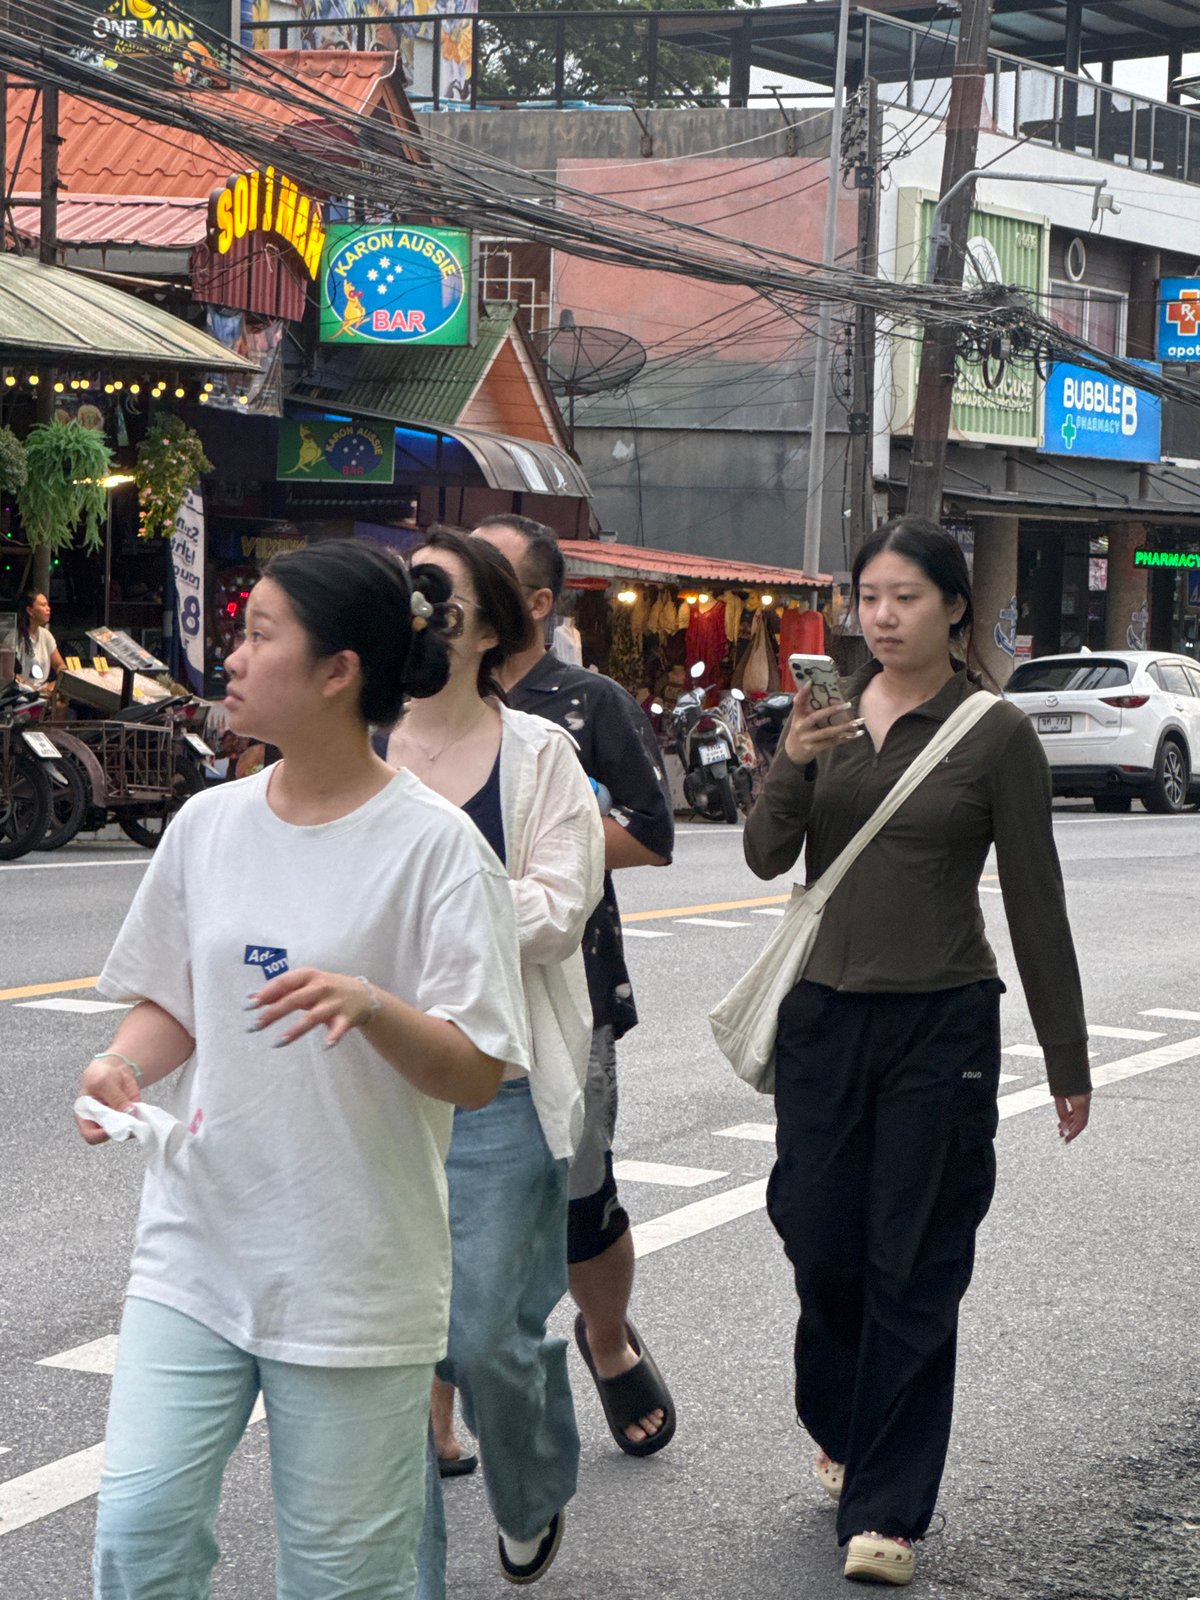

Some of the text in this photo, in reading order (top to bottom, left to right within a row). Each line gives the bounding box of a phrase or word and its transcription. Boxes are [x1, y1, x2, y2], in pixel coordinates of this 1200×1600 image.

[92, 16, 195, 40] ONE MAN
[217, 170, 260, 255] SOI
[334, 232, 457, 280] KARON AUSSIE
[373, 309, 426, 332] BAR
[1063, 377, 1138, 436] BUBBLE B
[1075, 415, 1121, 434] PHARMACY
[325, 426, 384, 456] KARON AUSSIE
[342, 465, 365, 476] BAR
[1135, 551, 1200, 568] PHARMACY
